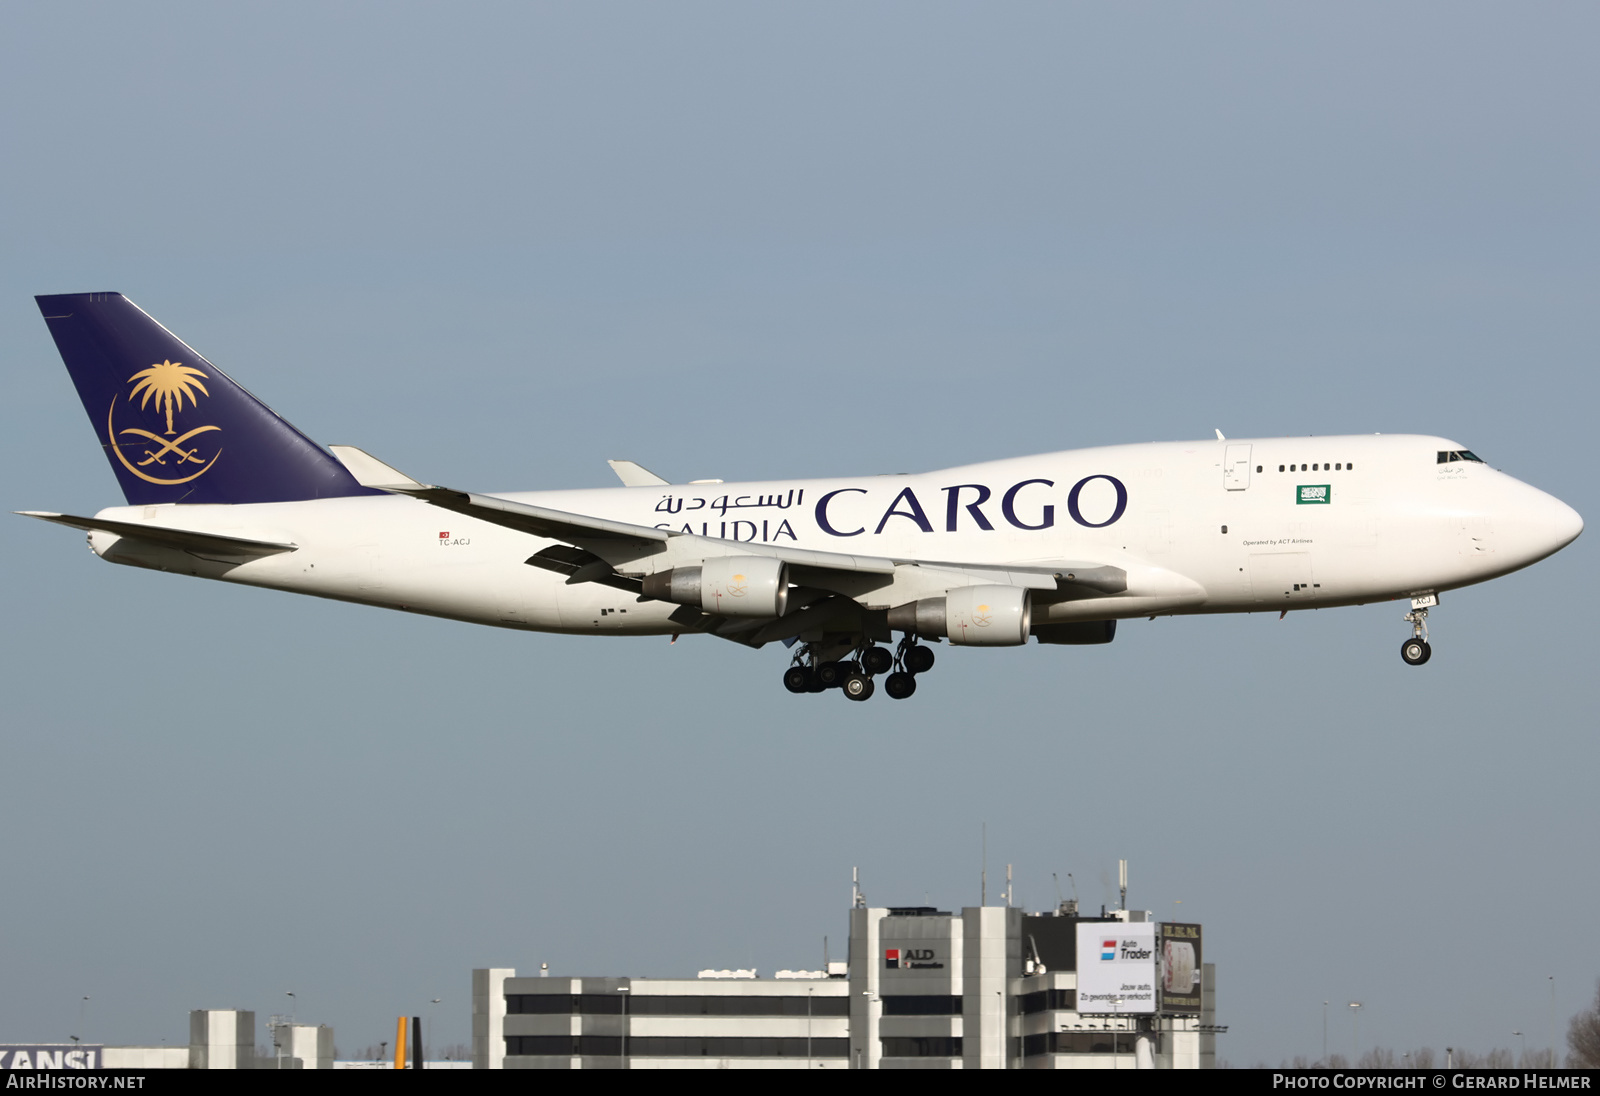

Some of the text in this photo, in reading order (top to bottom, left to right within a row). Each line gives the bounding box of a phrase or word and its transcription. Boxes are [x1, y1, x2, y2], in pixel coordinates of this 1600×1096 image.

[654, 488, 804, 518] السعودية
[814, 474, 1128, 537] CARGO
[439, 538, 471, 546] TC-ACJ
[1416, 597, 1431, 605] ACJ
[1121, 940, 1137, 948] Auto
[904, 949, 935, 961] ALD
[1121, 948, 1152, 960] Trader
